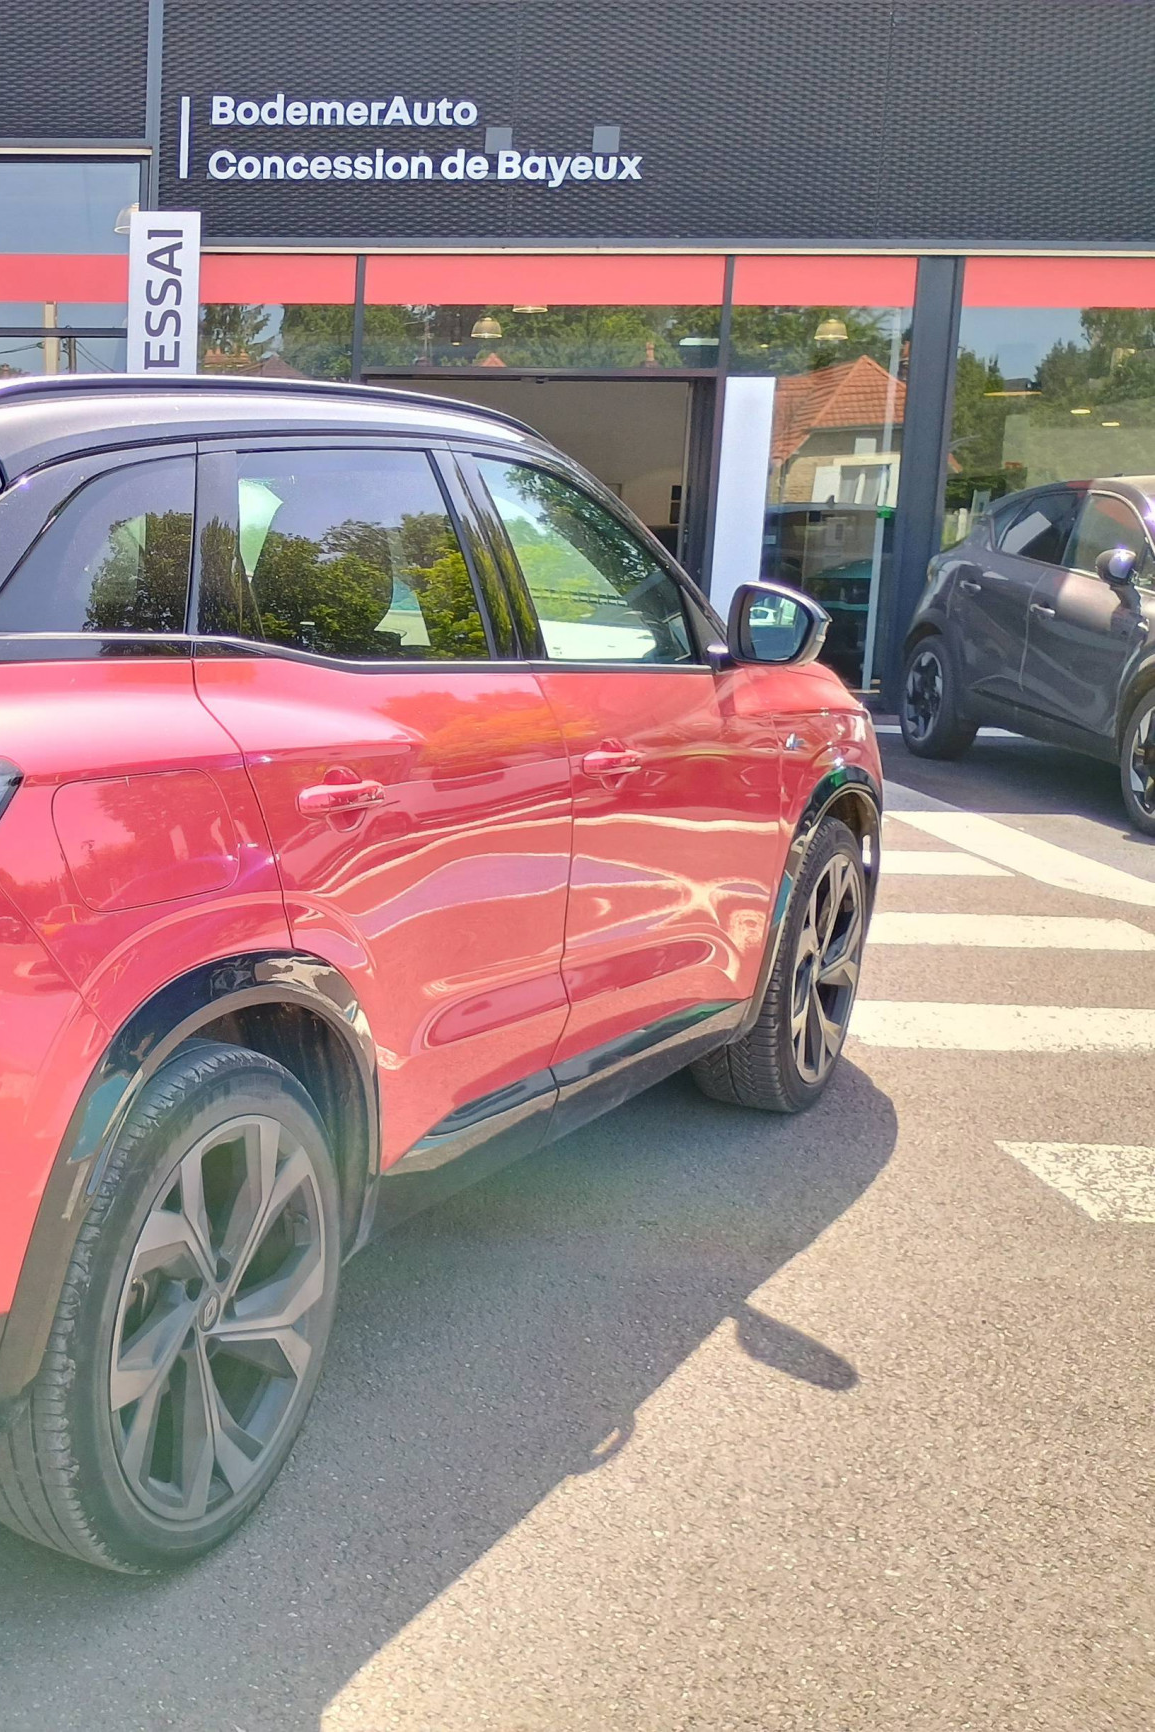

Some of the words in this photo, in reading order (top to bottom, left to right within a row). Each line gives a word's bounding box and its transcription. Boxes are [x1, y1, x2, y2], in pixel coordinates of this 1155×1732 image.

[210, 94, 478, 126] BodemerAuto
[208, 149, 435, 180] Concession
[440, 149, 489, 180] de
[497, 149, 643, 187] Bayeux
[144, 229, 183, 369] ESSAI
